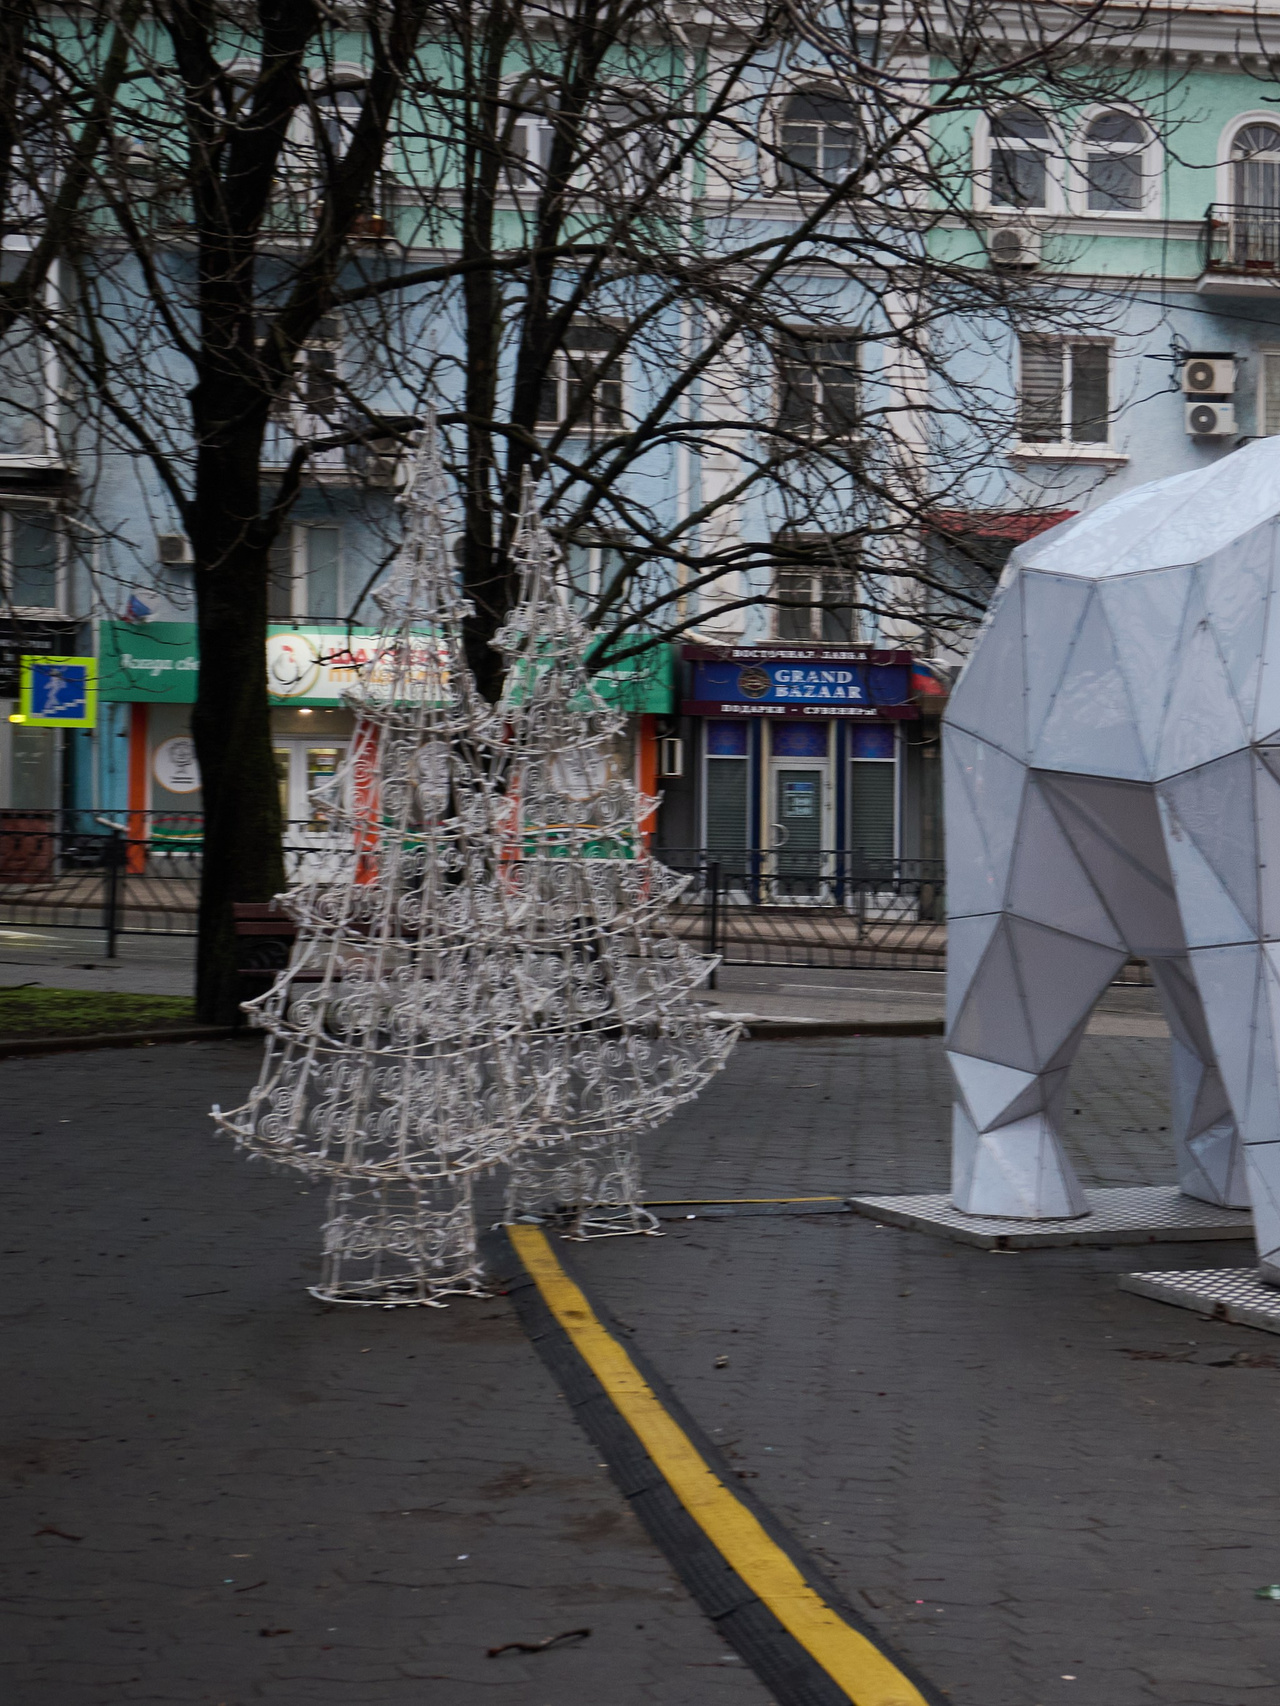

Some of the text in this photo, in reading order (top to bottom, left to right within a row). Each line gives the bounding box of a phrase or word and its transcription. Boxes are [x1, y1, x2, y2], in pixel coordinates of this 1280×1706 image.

[821, 651, 867, 660] ЛАВКА
[774, 670, 853, 684] GRAND
[775, 686, 863, 699] BAZAAR
[721, 705, 786, 714] ПОДАРКИ
[803, 707, 877, 716] СУВЕНИРЫ
